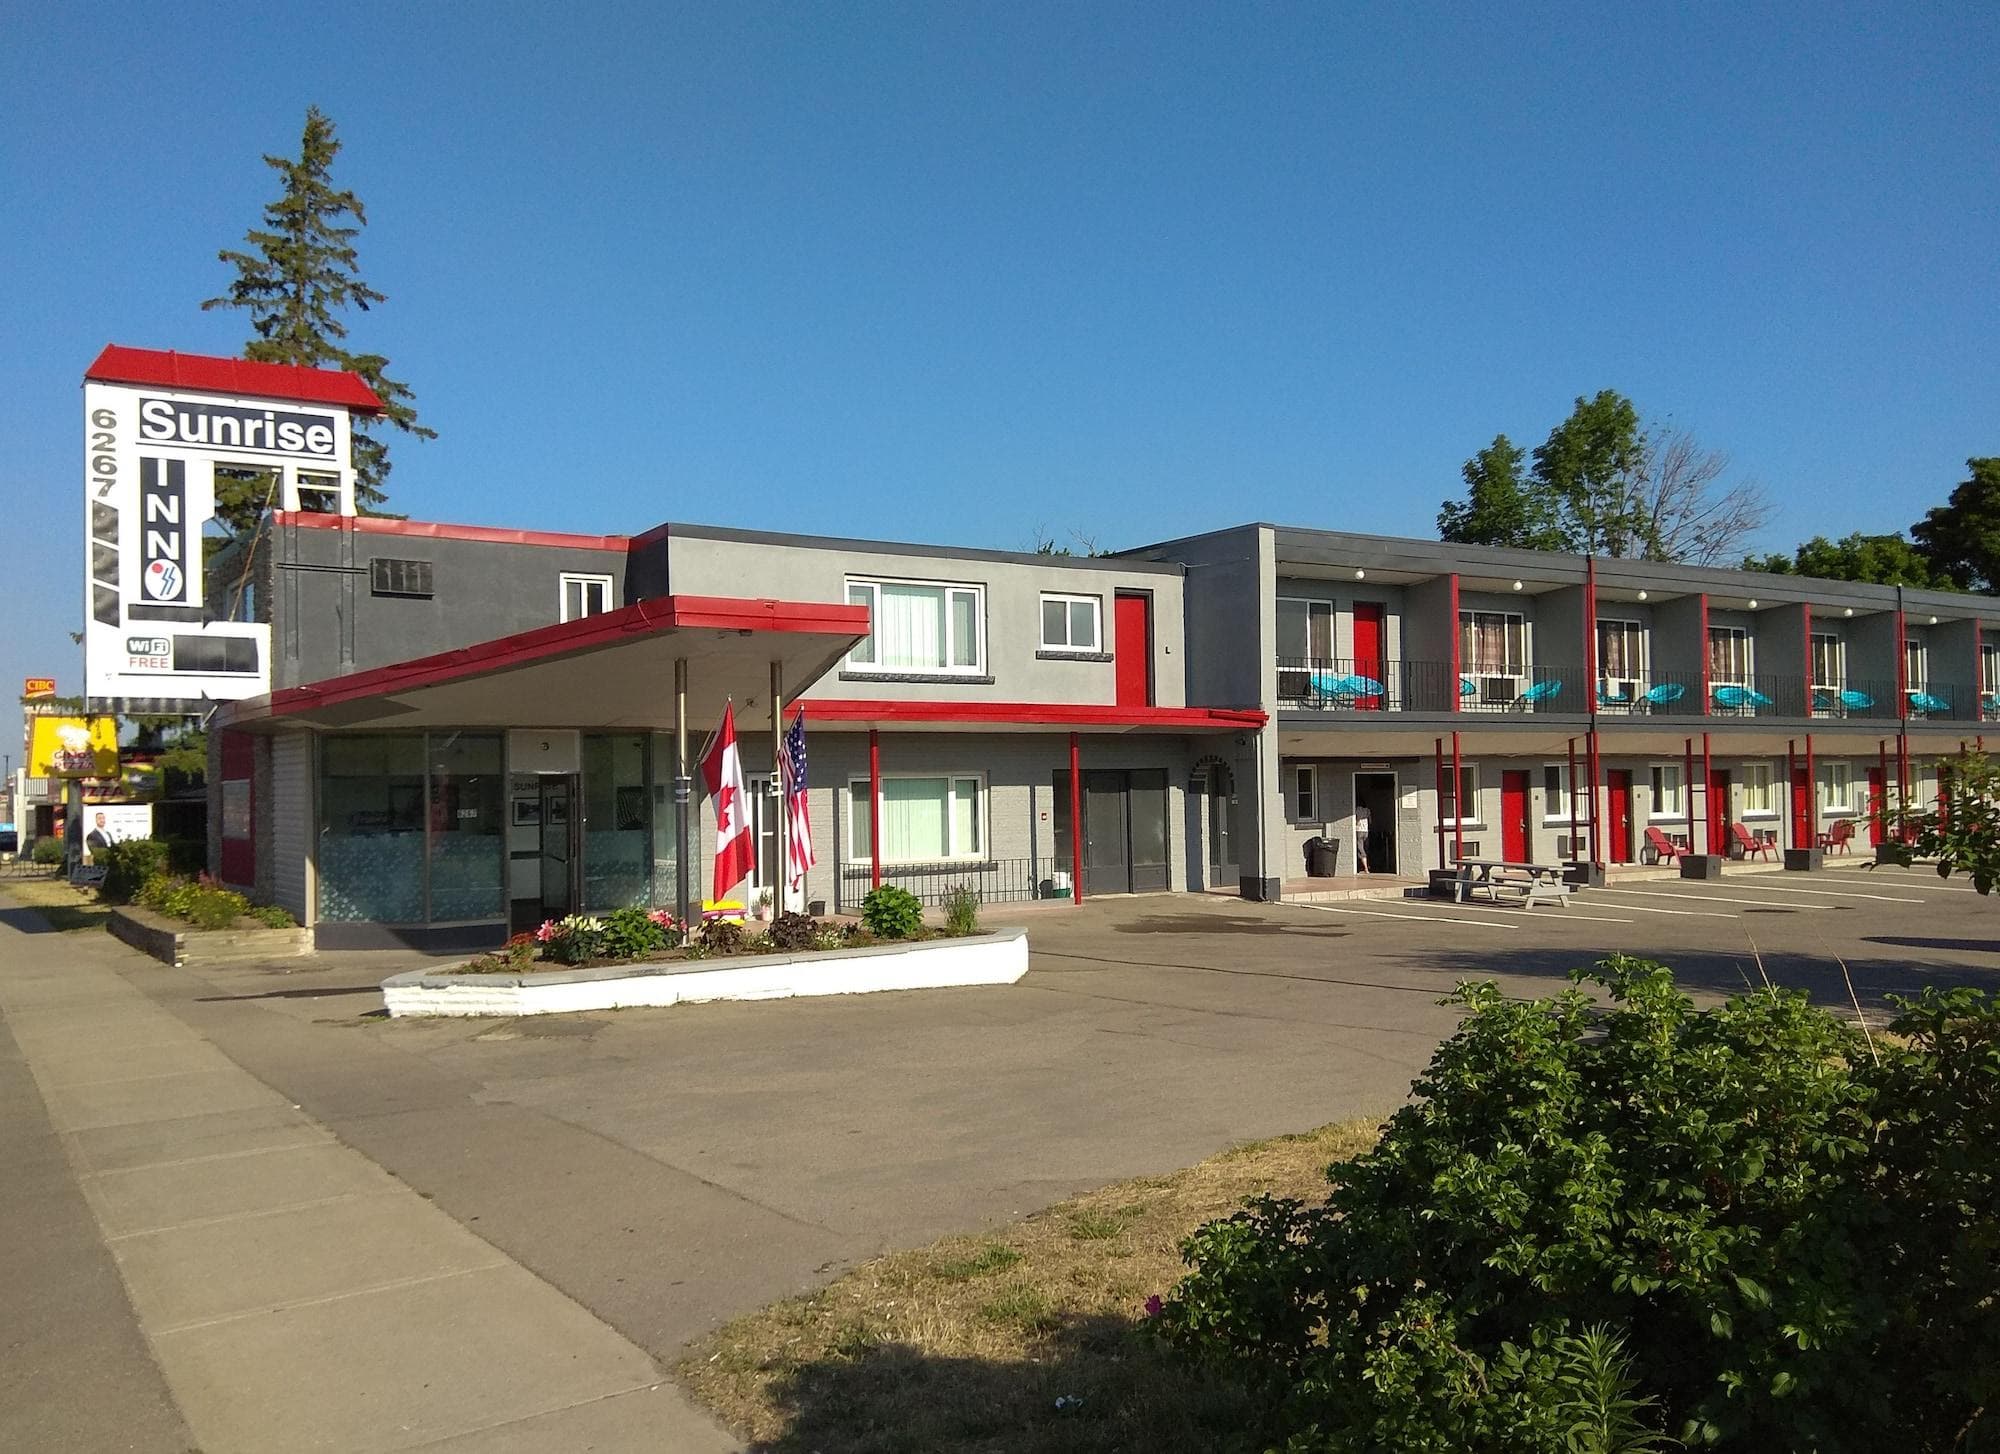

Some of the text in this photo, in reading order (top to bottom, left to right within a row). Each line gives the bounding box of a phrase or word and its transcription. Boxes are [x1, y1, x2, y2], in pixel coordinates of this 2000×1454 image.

[141, 400, 334, 454] Sunrise
[91, 408, 118, 497] 6267
[146, 458, 179, 560] INN
[128, 639, 168, 653] WiFi
[129, 656, 169, 668] FREE
[26, 680, 54, 691] CIBC
[82, 786, 124, 797] IZZA
